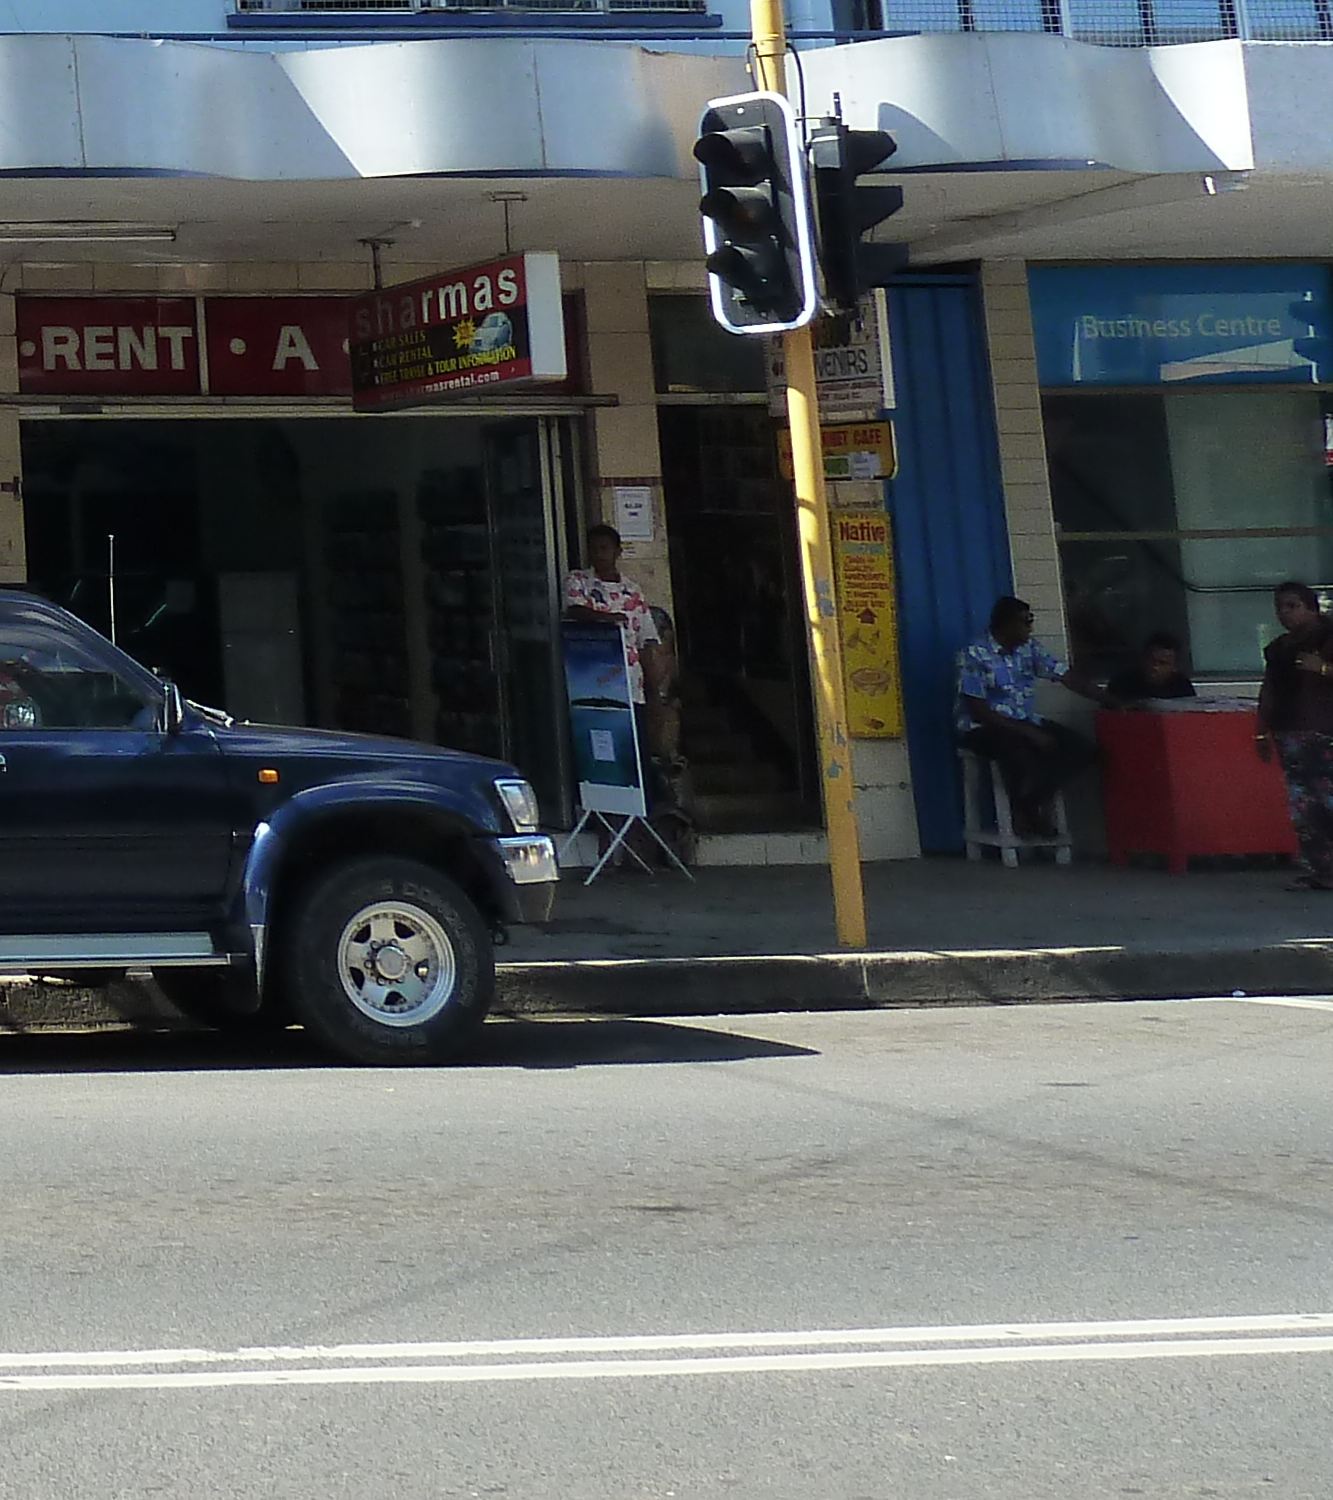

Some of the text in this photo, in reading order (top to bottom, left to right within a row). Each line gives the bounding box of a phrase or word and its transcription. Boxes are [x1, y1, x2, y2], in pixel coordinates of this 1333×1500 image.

[356, 268, 519, 338] sharmas
[399, 330, 426, 345] SALES
[1083, 314, 1281, 338] Business Centre
[41, 325, 320, 371] RENT A
[399, 346, 434, 363] RENTAL
[435, 359, 457, 372] TOUR
[458, 346, 516, 370] INFORMATION
[839, 521, 886, 542] Native
